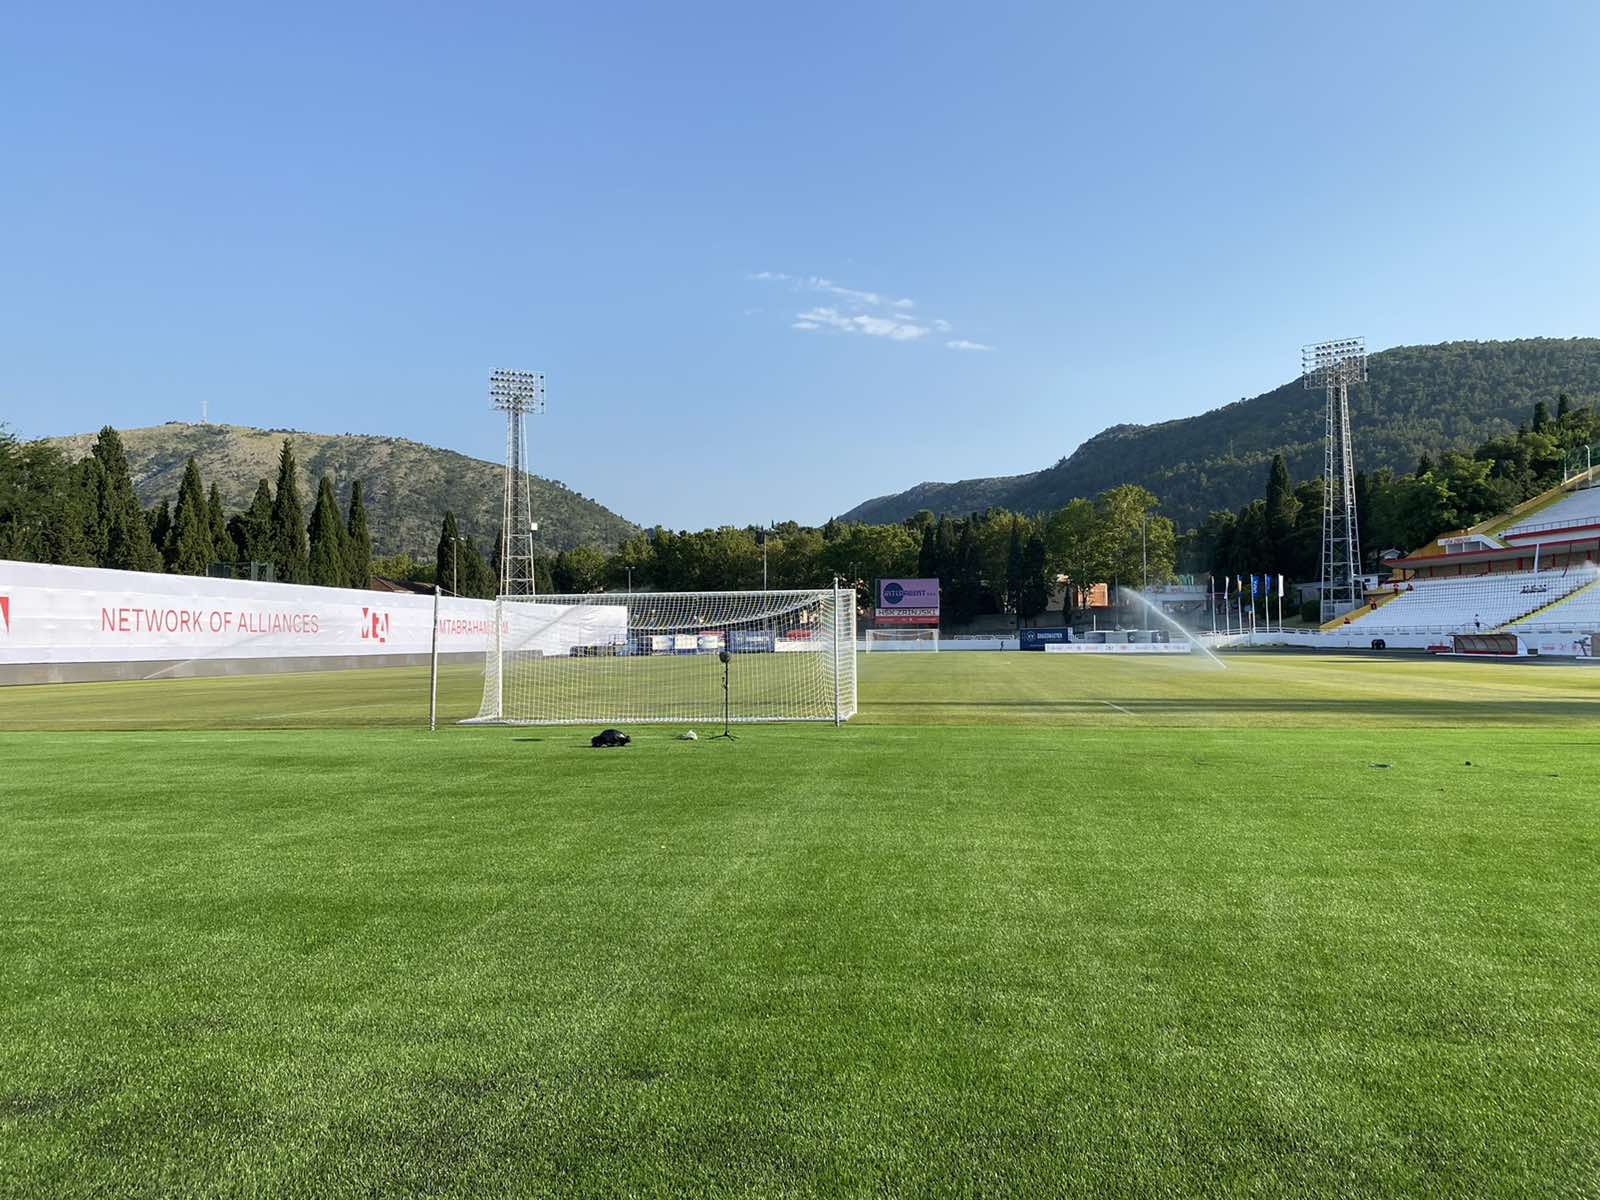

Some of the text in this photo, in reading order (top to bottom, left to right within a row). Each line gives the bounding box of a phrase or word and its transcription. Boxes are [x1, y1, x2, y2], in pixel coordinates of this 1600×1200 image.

[101, 607, 319, 633] NETWORK OF ALLIANCES
